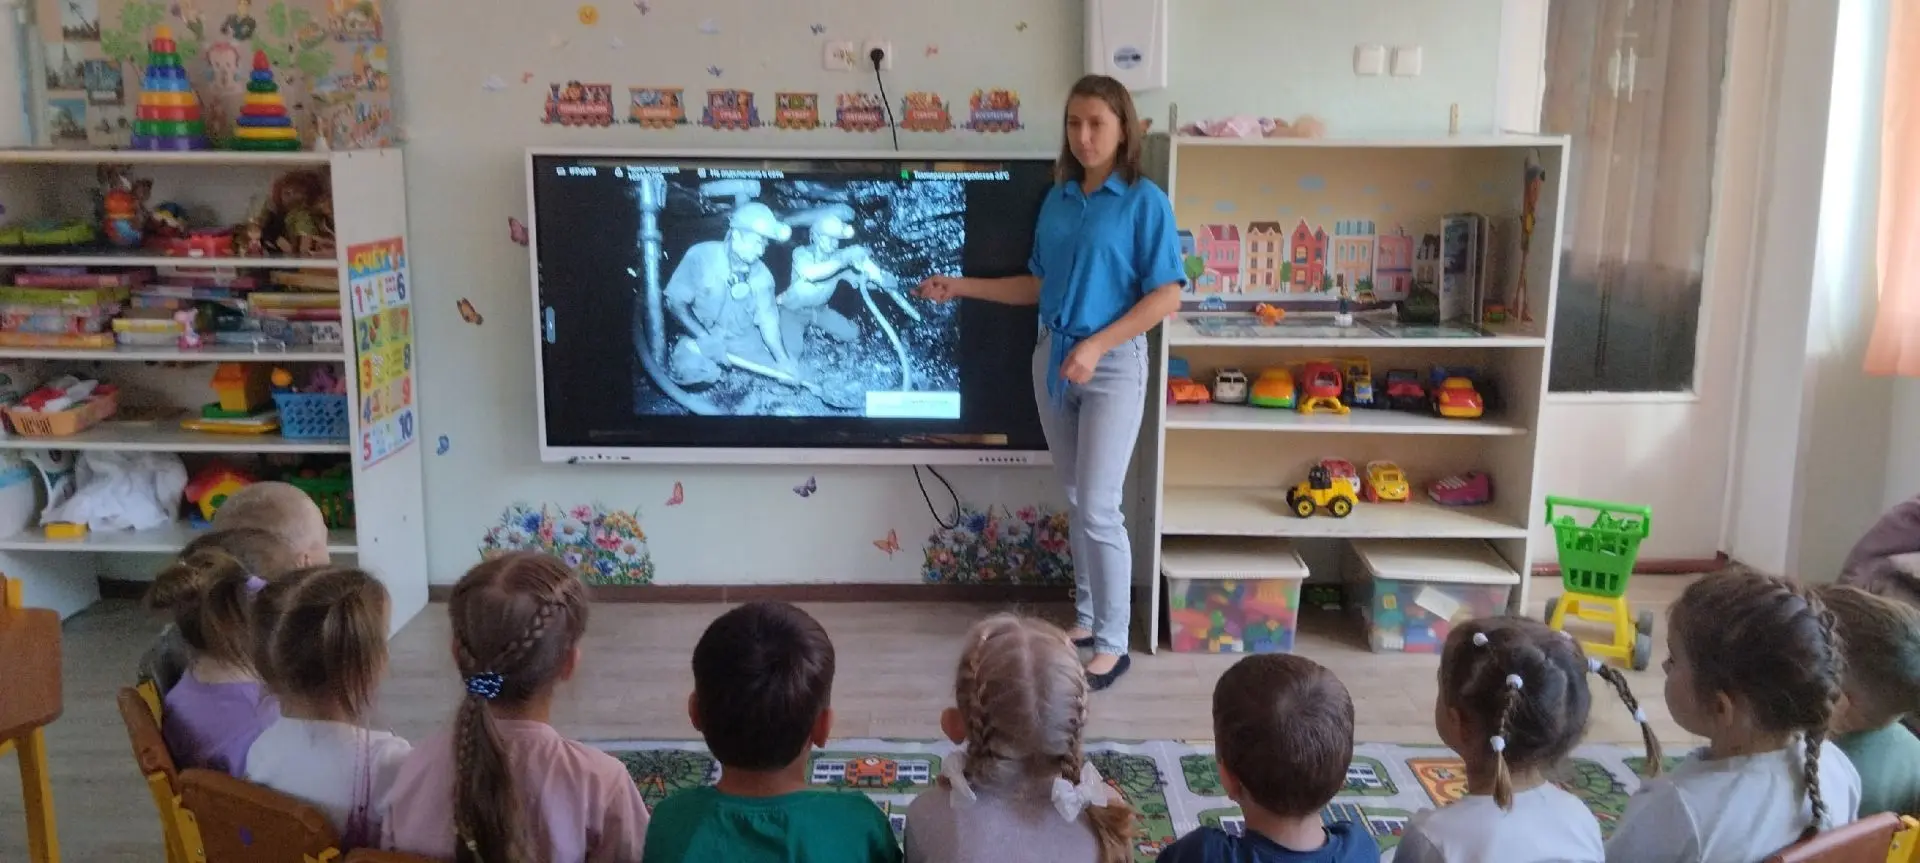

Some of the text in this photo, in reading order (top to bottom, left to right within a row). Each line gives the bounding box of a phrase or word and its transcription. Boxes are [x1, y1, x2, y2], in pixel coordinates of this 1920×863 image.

[397, 271, 406, 300] 6
[360, 320, 370, 351] 2
[401, 308, 410, 336] 7
[403, 342, 411, 370] 8
[363, 357, 372, 390] 3
[402, 375, 411, 405] 9
[363, 395, 372, 424] 4
[399, 409, 413, 440] 10
[363, 432, 372, 461] 5
